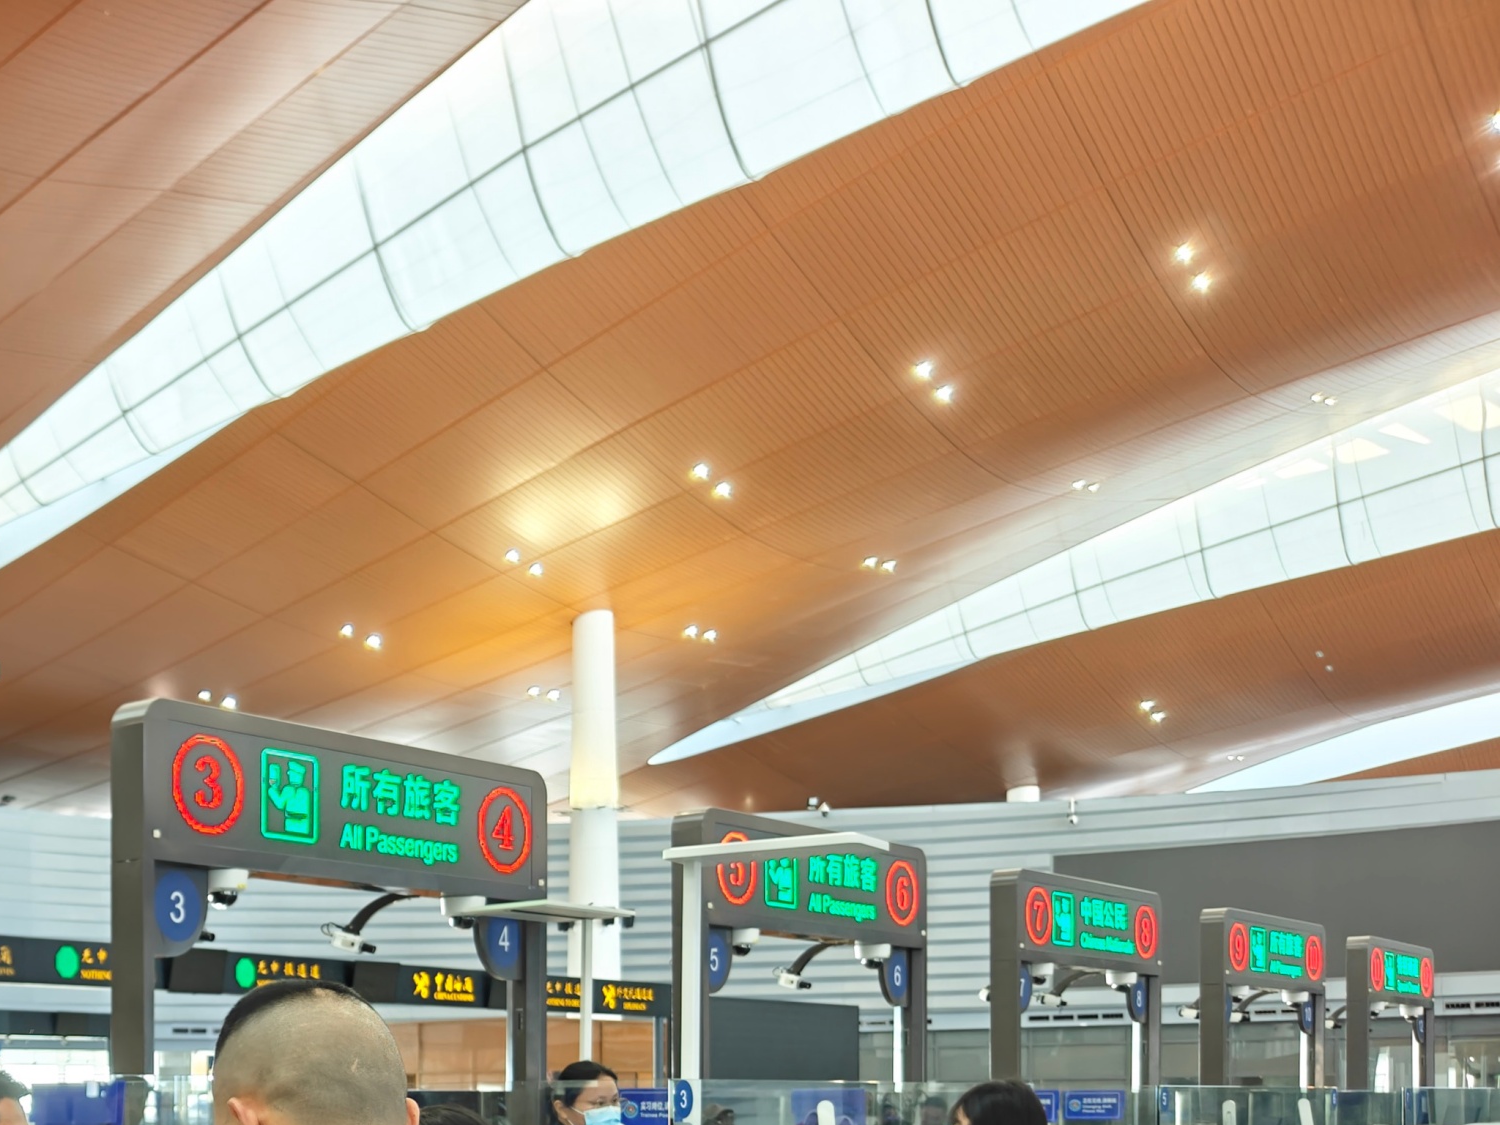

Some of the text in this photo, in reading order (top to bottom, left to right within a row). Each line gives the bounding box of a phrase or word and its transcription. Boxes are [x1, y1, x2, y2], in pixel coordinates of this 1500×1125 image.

[193, 754, 223, 809] 3
[340, 763, 461, 827] 所有旅客
[339, 822, 459, 866] All Passengers
[807, 853, 878, 893] 所有旅客
[169, 890, 186, 924] 3
[807, 892, 877, 922] All Passengers
[498, 925, 510, 952] 4
[709, 947, 719, 971] 5
[893, 965, 901, 987] 6
[680, 1089, 687, 1109] 3
